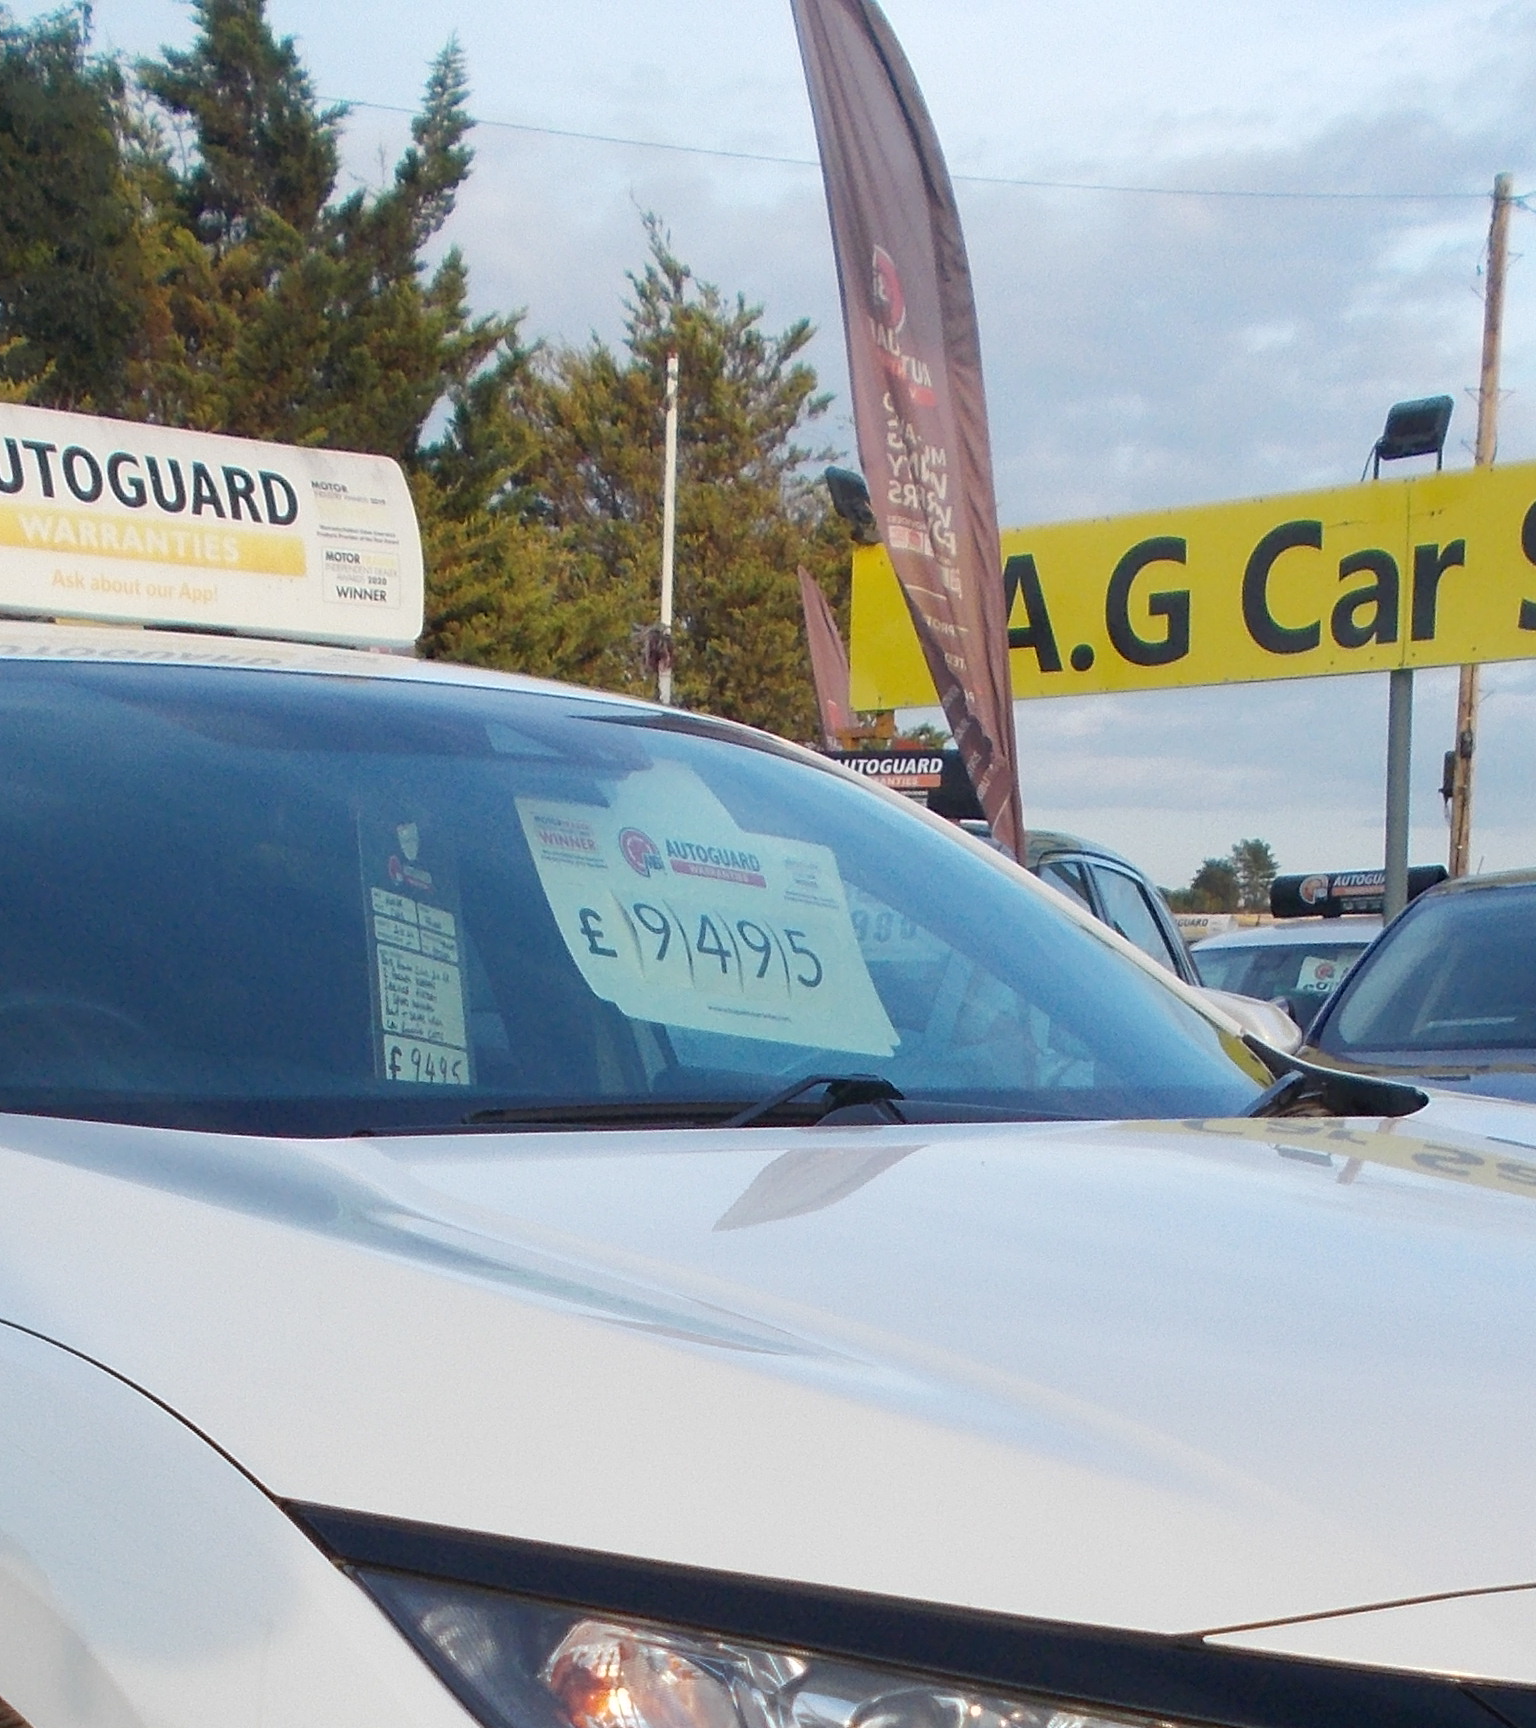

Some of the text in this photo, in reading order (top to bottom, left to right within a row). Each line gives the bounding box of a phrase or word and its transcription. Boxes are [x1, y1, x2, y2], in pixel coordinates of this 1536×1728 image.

[19, 513, 240, 563] WARRANTIES
[325, 551, 361, 565] MOTOR
[52, 568, 219, 605] Ask about our App!
[335, 586, 387, 602] WINNER
[1241, 519, 1465, 655] Car
[665, 839, 761, 872] AUTOGUARD
